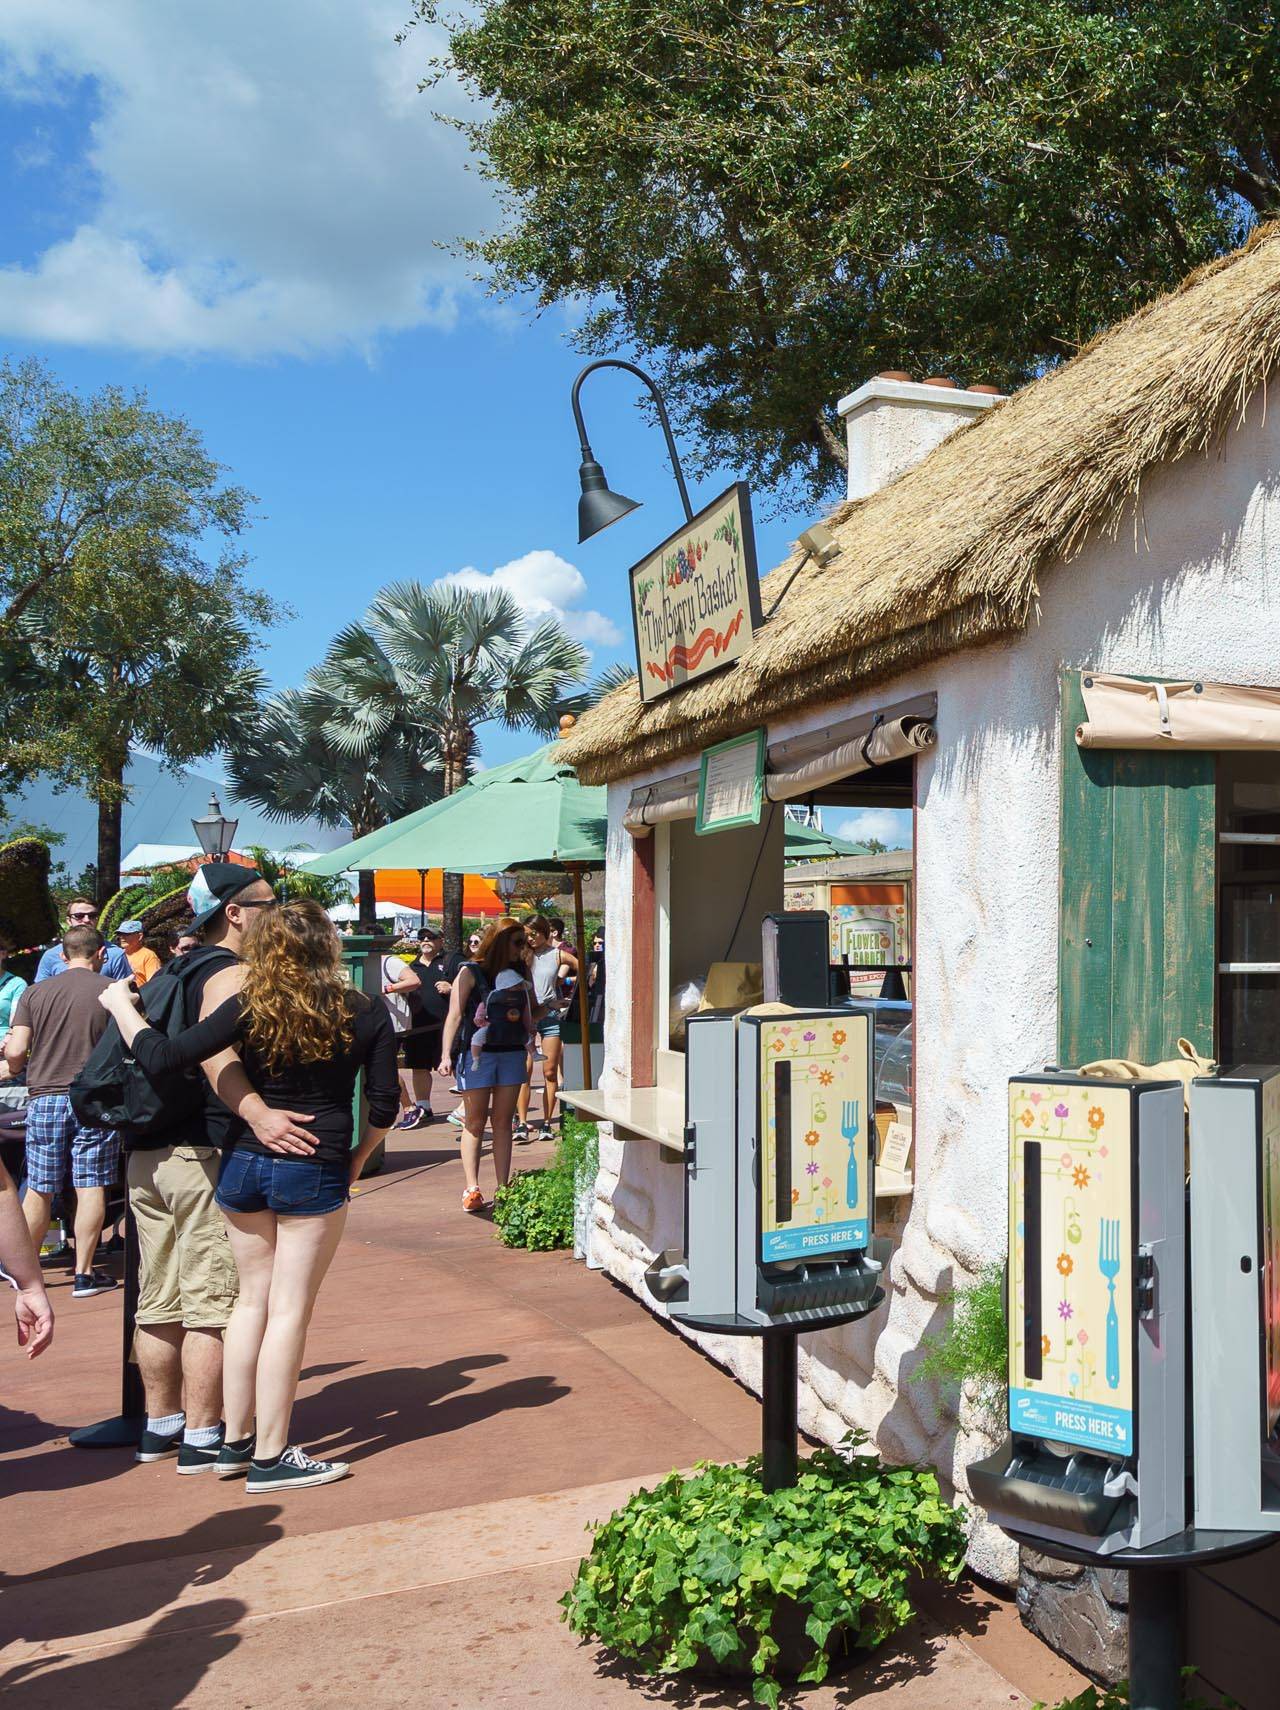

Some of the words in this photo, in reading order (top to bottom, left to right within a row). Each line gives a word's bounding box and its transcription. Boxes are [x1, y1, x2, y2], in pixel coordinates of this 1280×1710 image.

[644, 609, 663, 654] The
[663, 595, 697, 636] Berry
[694, 557, 738, 620] Basket
[846, 927, 881, 954] FLOWER
[853, 950, 886, 966] GARDEN
[851, 975, 869, 984] RESH
[869, 973, 885, 981] EPCO
[802, 1233, 829, 1248] PRESS
[831, 1230, 853, 1243] HERE
[1055, 1411, 1087, 1432] PRESS
[1089, 1418, 1114, 1438] HERE
